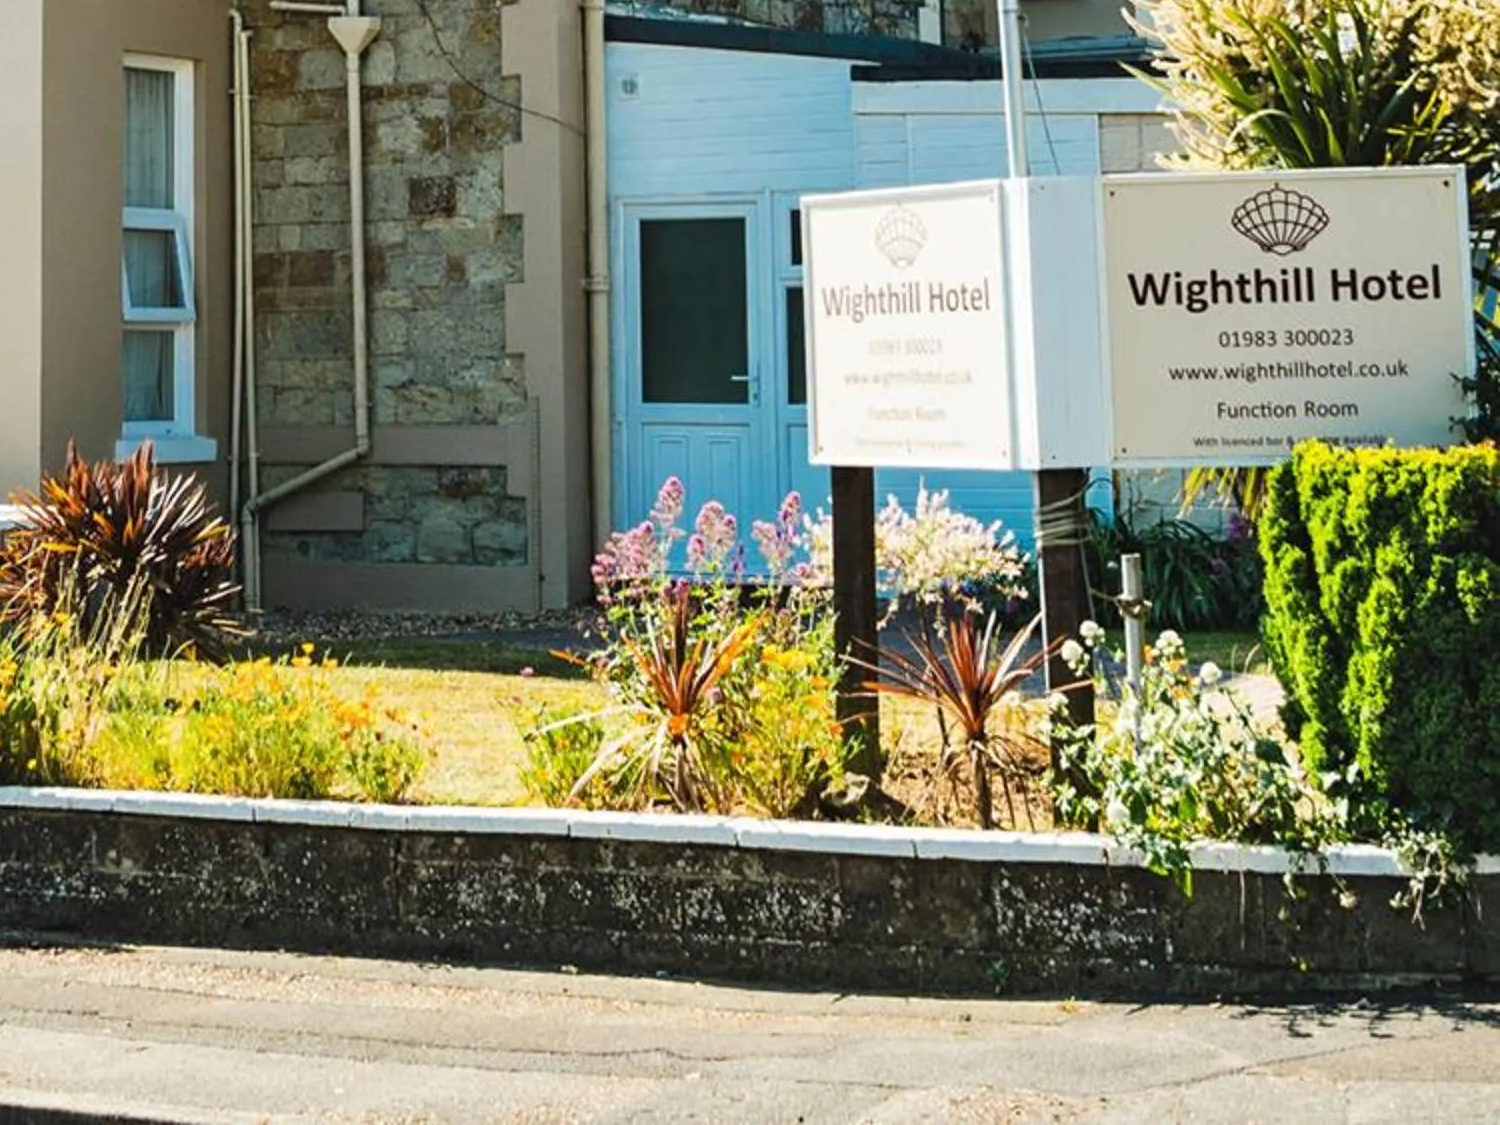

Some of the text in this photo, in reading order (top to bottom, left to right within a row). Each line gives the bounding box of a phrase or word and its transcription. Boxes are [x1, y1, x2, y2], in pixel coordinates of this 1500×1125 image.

[821, 277, 991, 324] Wighthill Hotel
[1127, 263, 1442, 314] Wighthill Hotel
[1218, 328, 1355, 349] 01983 300023
[1168, 359, 1409, 383] www.wighthillhotel.co.uk
[1217, 400, 1360, 420] Function Room
